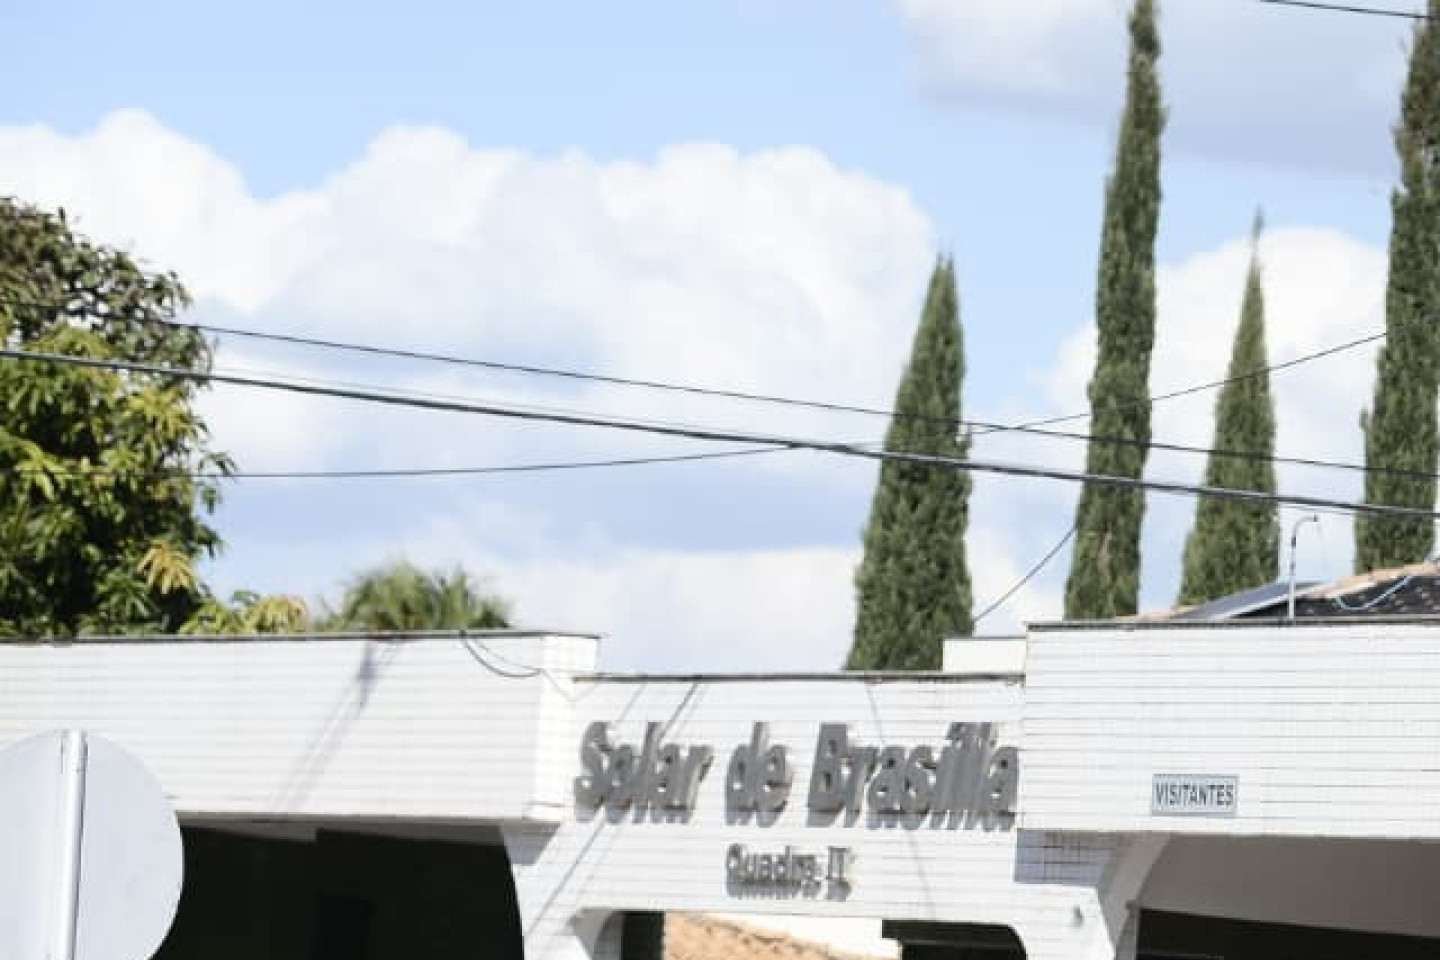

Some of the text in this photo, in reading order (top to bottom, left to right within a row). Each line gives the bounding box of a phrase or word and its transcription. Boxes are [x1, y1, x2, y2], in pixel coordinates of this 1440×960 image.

[575, 721, 713, 818] Solar
[725, 721, 793, 820] de
[1155, 783, 1234, 808] VISITANTES
